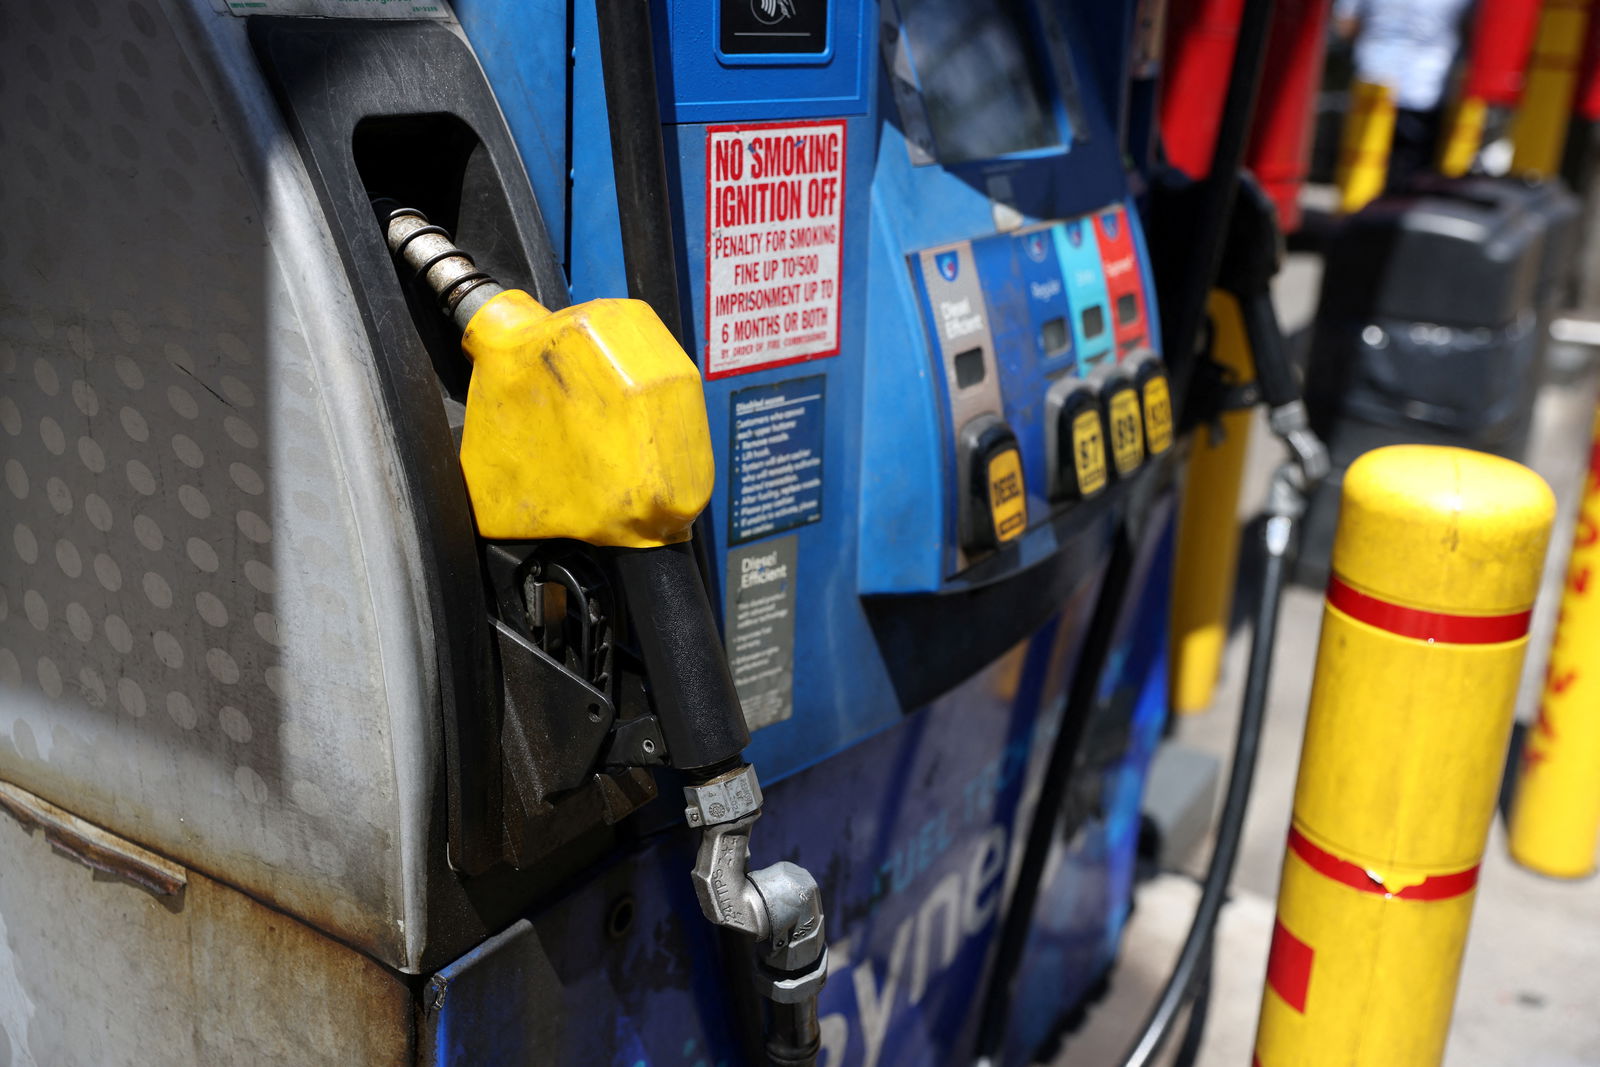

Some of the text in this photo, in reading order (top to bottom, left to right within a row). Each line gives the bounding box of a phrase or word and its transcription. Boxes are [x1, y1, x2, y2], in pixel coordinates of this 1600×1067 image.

[715, 133, 838, 181] NO SMOKING
[715, 177, 837, 228] IGNITION OFF
[715, 225, 835, 257] PENALTY FOR SMOKING
[735, 262, 759, 285] FINE
[763, 259, 778, 282] UP
[782, 258, 795, 279] TO
[716, 280, 833, 317] IMPRISONMENT UP TO
[721, 307, 827, 343] 6 MONTHS OR BOTH
[721, 348, 729, 359] BY
[756, 341, 763, 353] OF
[741, 551, 777, 573] Diesel
[741, 564, 787, 589] Efficient
